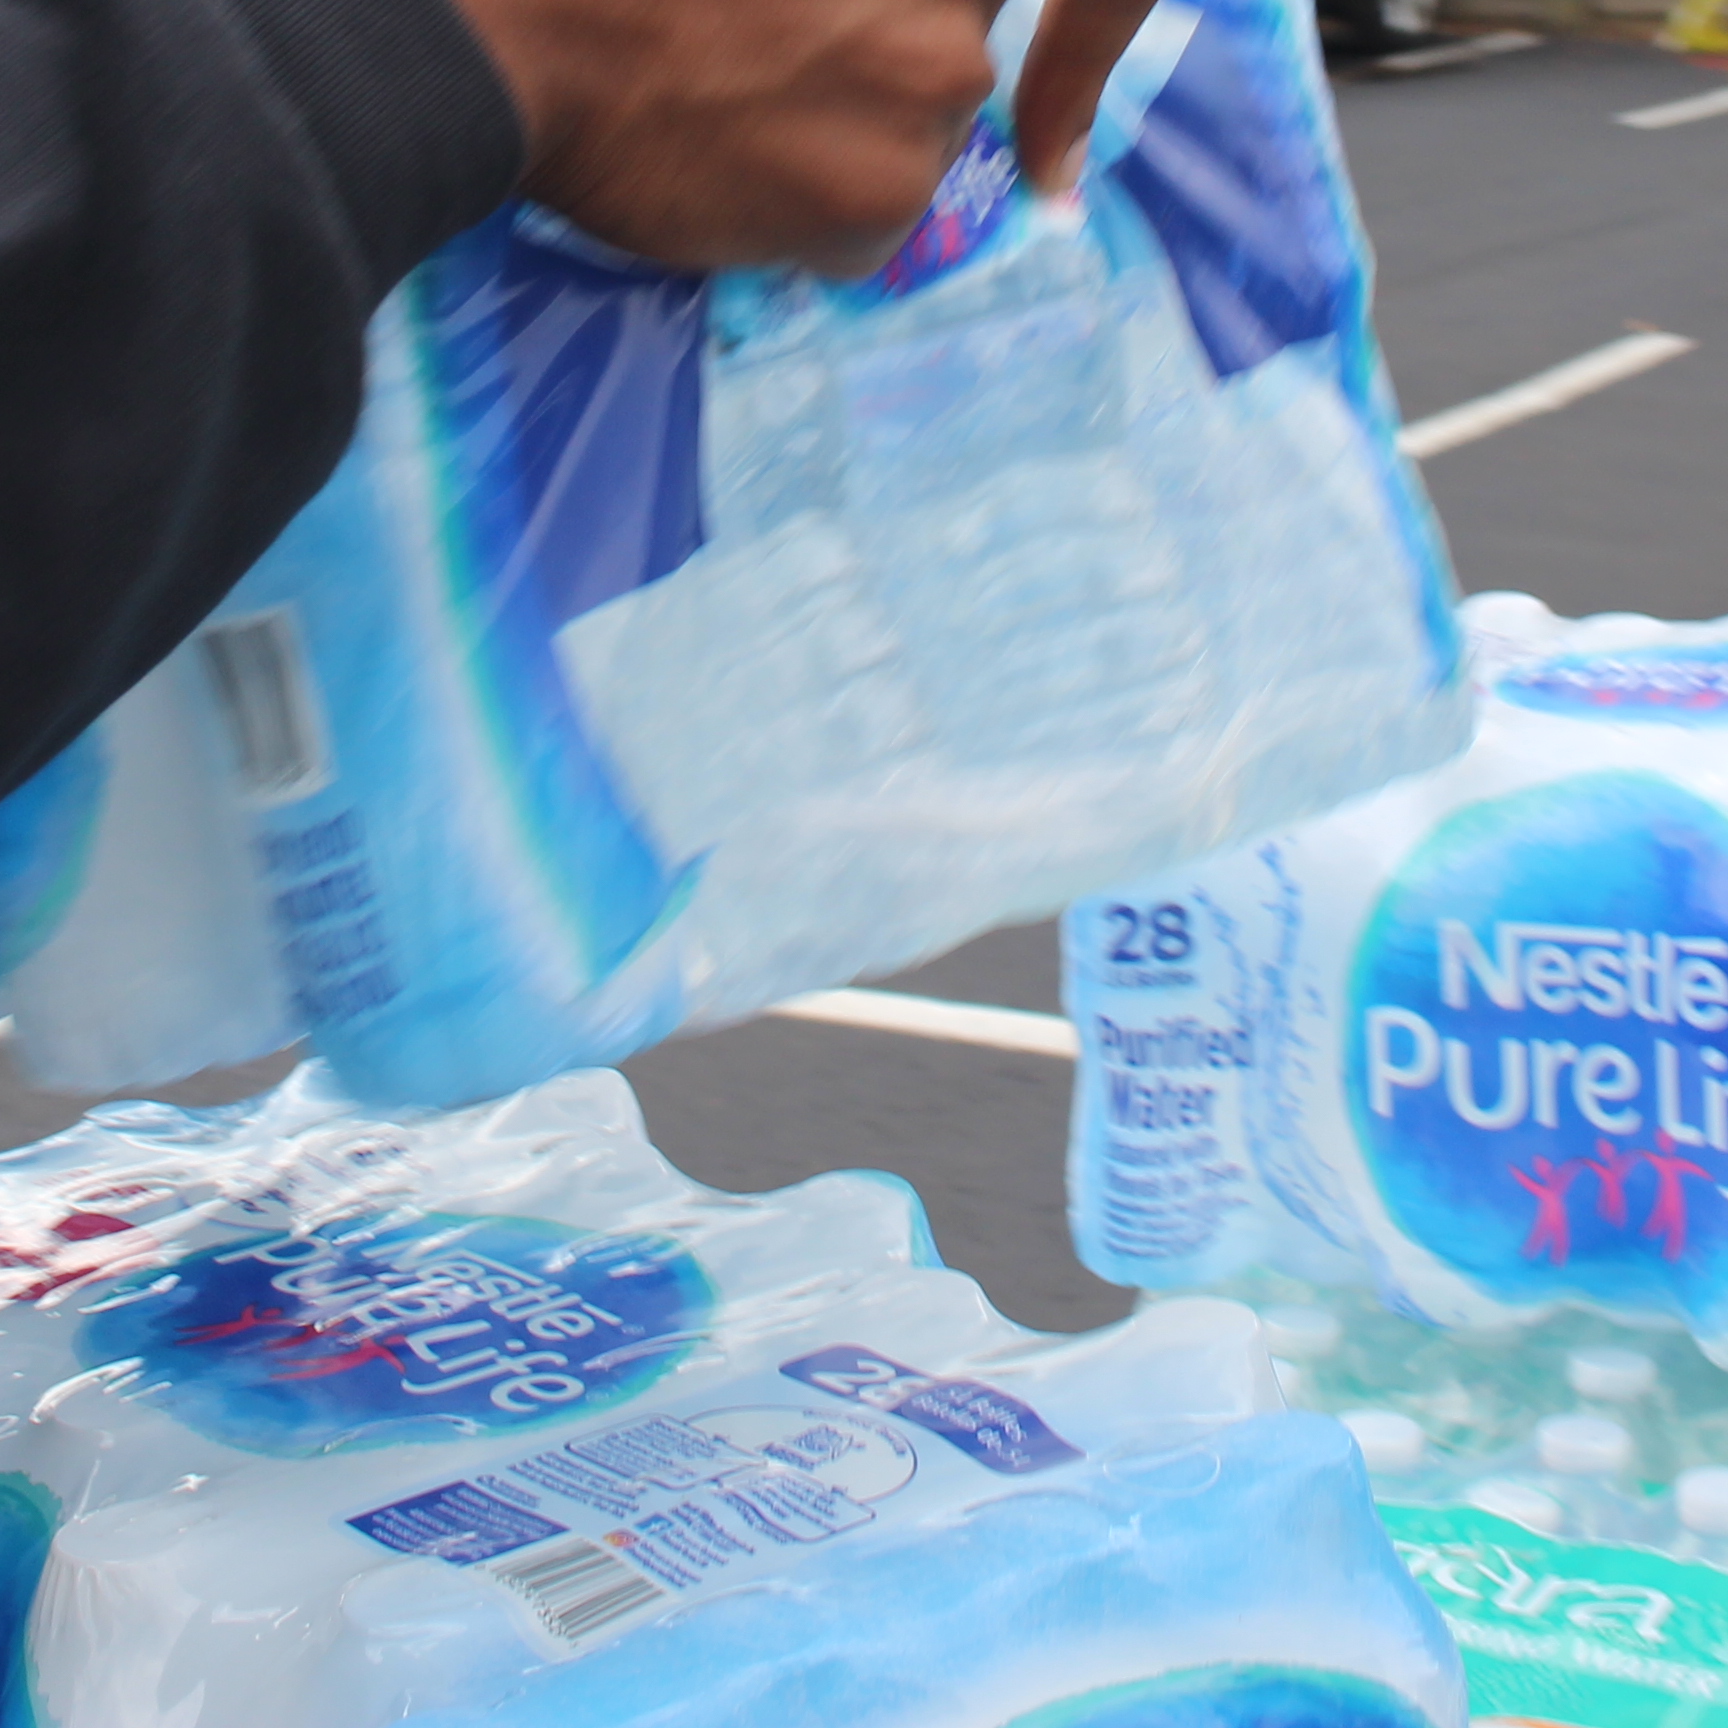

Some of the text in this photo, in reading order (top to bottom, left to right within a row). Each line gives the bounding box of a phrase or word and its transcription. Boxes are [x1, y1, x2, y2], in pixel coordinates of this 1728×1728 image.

[1104, 902, 1194, 963] 28
[1094, 1013, 1253, 1070] Purified
[1364, 1003, 1643, 1137] Pure
[1103, 1068, 1216, 1131] Water
[400, 1318, 588, 1414] Life
